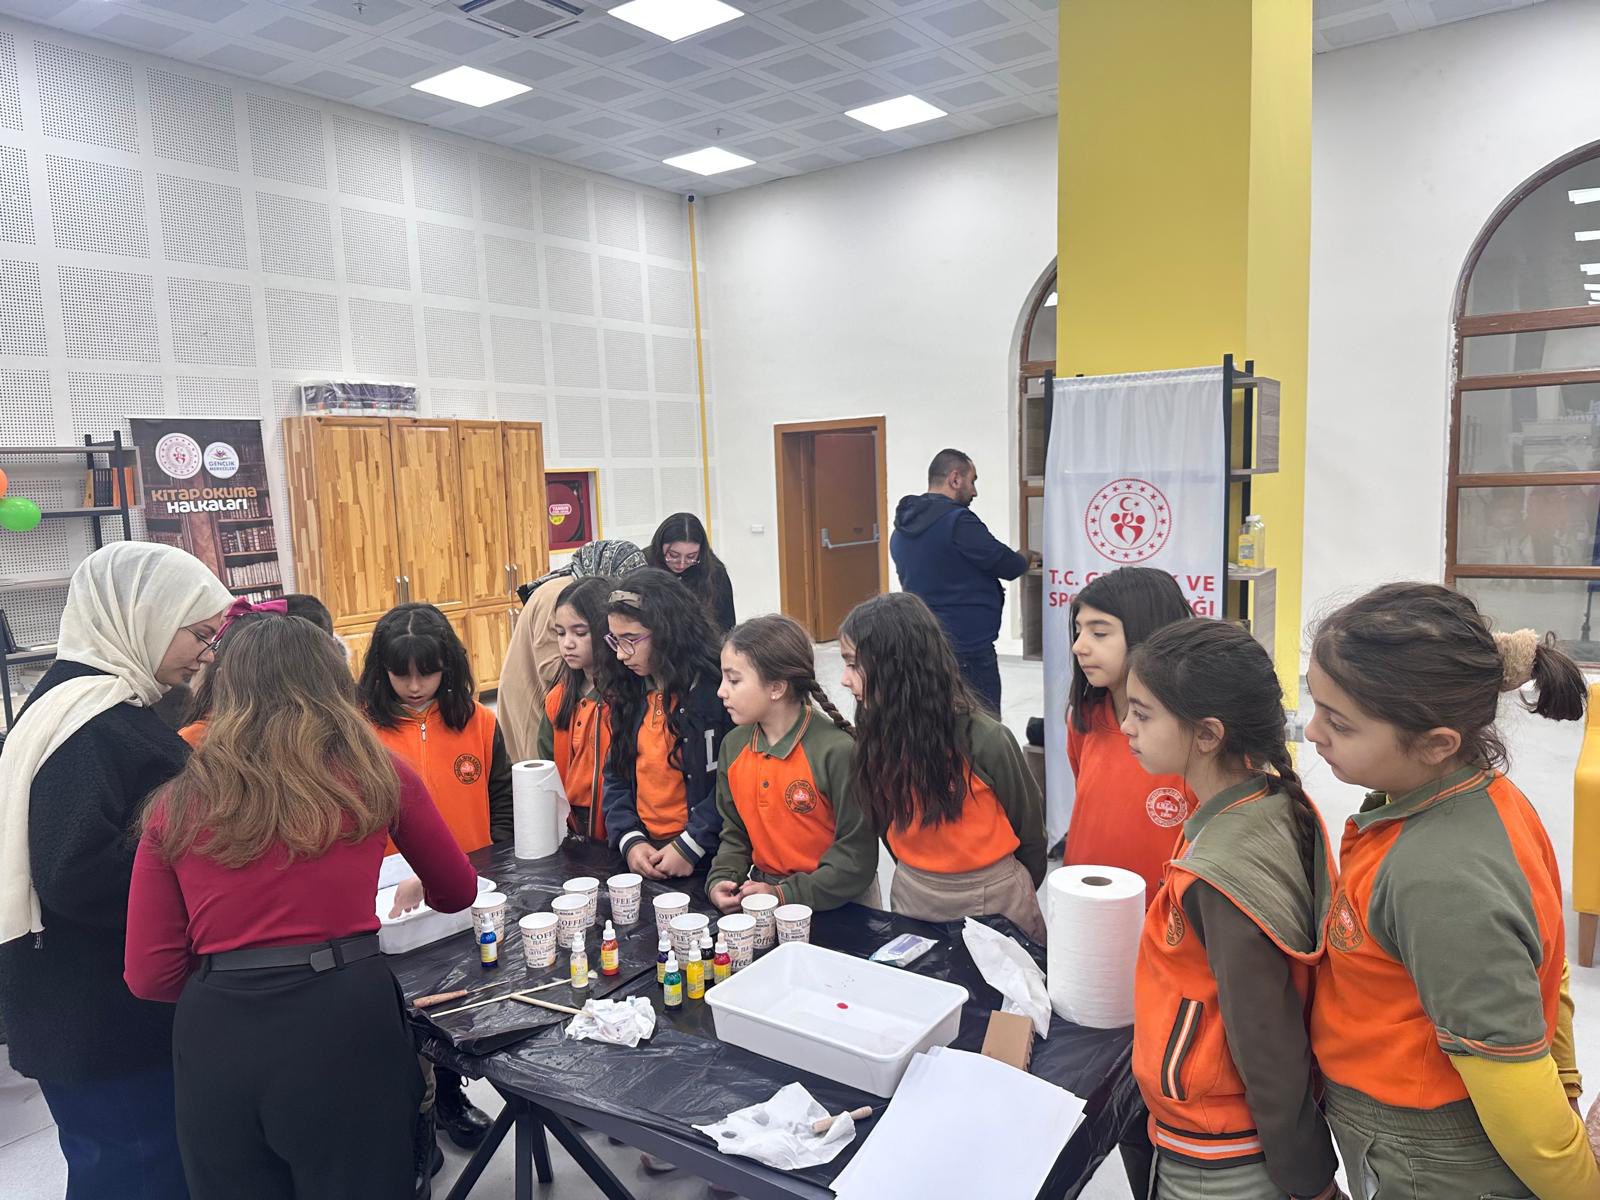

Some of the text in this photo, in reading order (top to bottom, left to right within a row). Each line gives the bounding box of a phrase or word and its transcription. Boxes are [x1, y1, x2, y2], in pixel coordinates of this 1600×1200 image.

[1049, 569, 1079, 585] T.C.
[1187, 575, 1215, 592] VE
[704, 729, 718, 772] L
